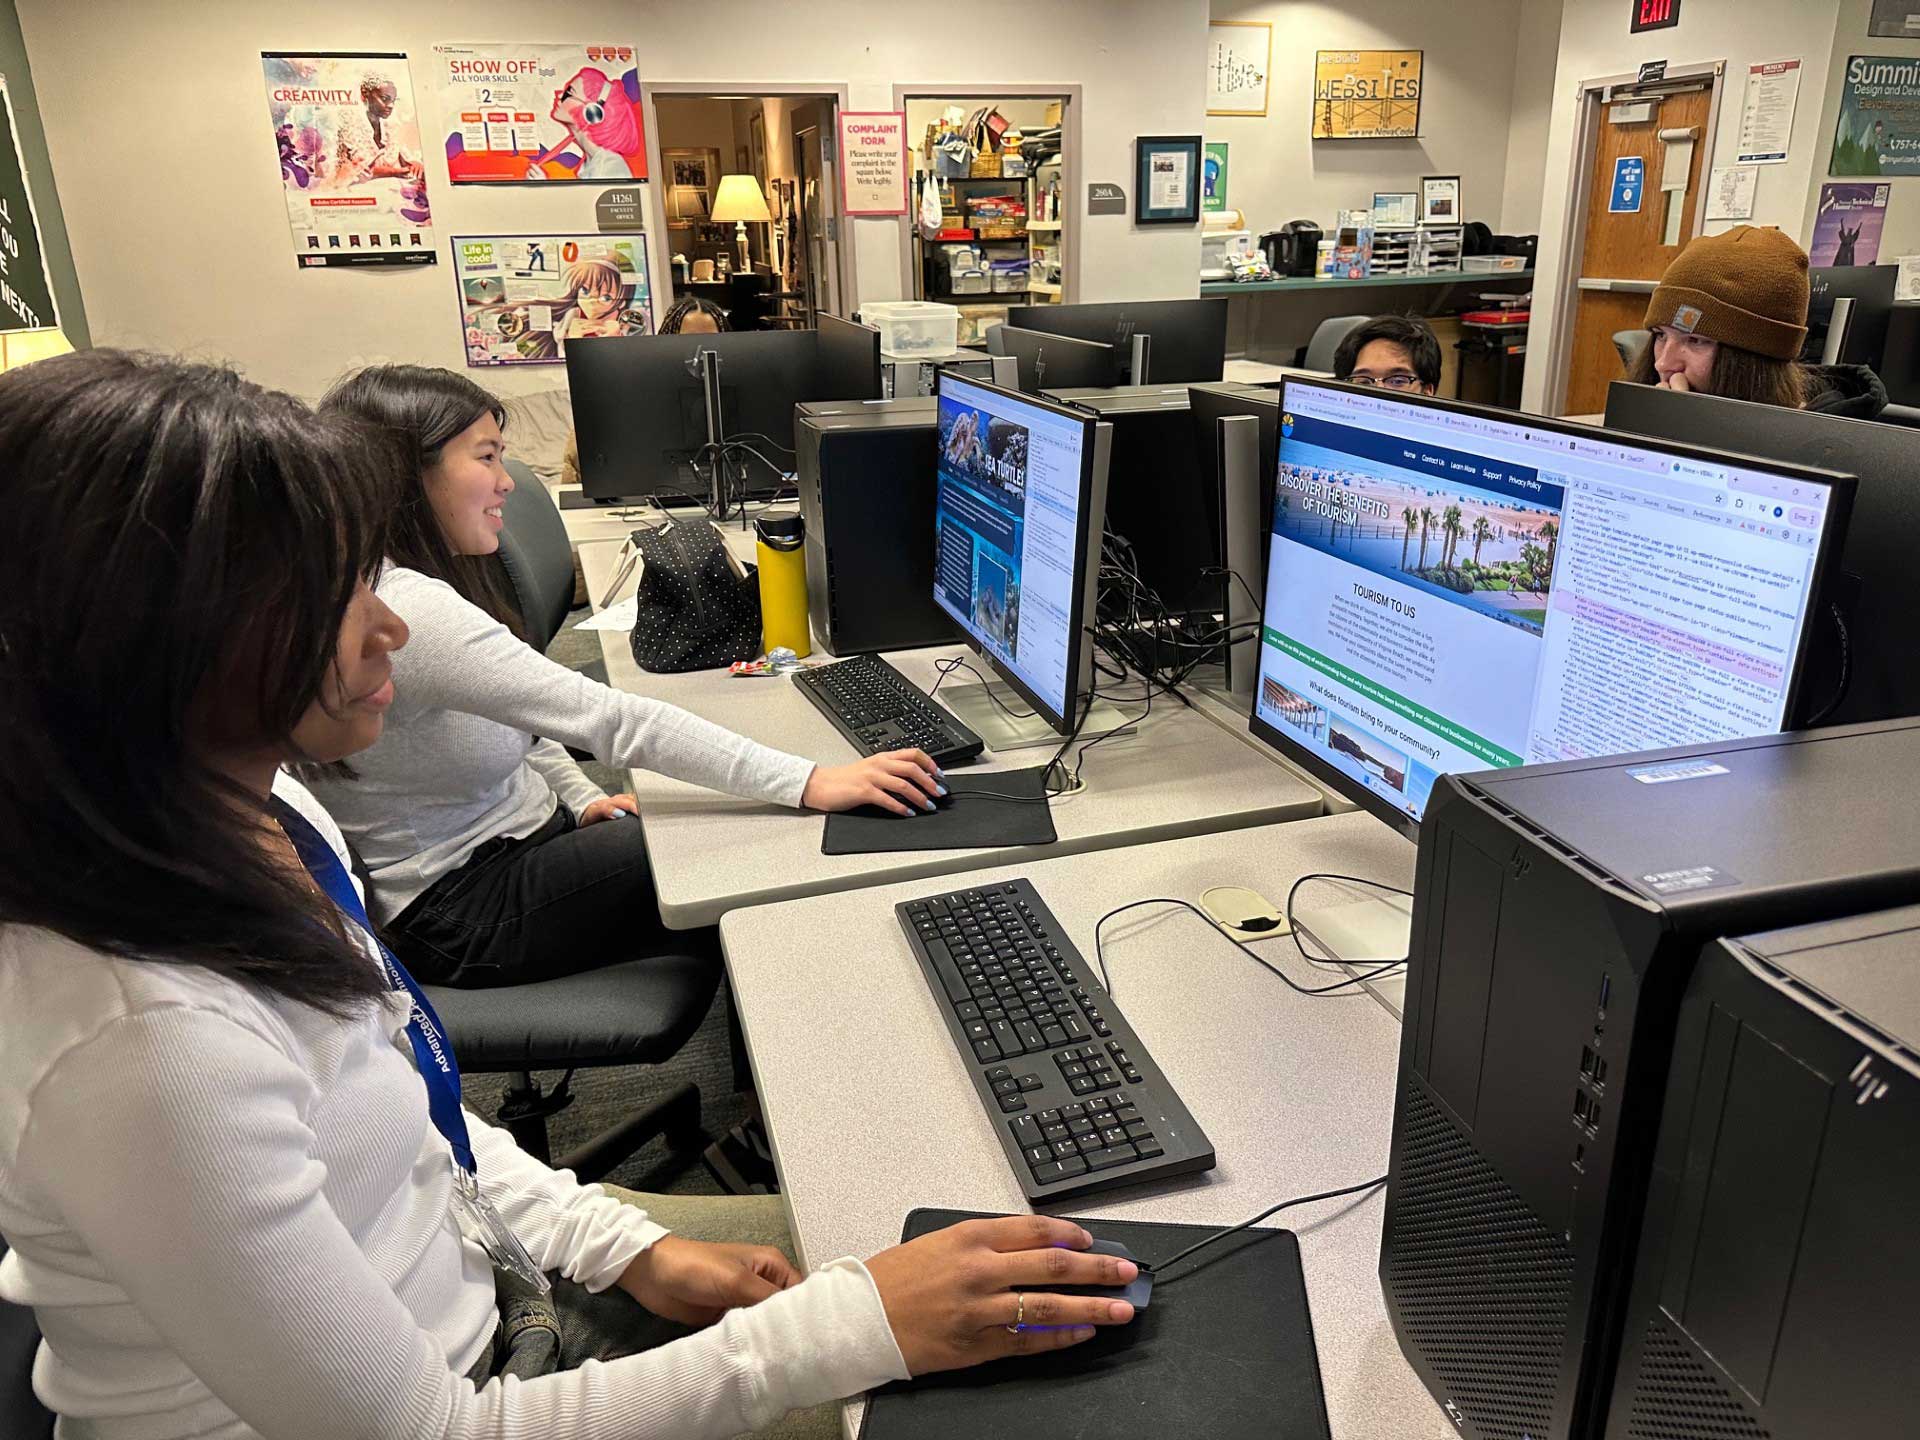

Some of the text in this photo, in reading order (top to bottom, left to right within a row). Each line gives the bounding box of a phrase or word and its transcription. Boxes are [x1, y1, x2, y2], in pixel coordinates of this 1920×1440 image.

[450, 60, 537, 74] SHOW OFF
[1848, 57, 1920, 85] Summi
[452, 75, 466, 83] ALL
[1318, 68, 1418, 98] WEBSITES
[273, 89, 352, 101] CREATIVITY
[482, 89, 492, 103] 2
[1854, 84, 1883, 97] Design
[847, 125, 898, 134] COMPLAINT
[860, 136, 886, 145] FORM
[849, 150, 867, 158] Please
[612, 194, 633, 203] H261
[463, 244, 492, 255] Life in
[467, 255, 491, 264] code
[1403, 449, 1416, 459] Home
[1421, 453, 1445, 466] Contact Us
[984, 454, 1025, 488] SEA TURTLES
[1449, 461, 1476, 474] Learn More
[1482, 468, 1502, 480] Support
[1508, 474, 1526, 488] Privacy
[1526, 479, 1541, 492] Policy
[1279, 471, 1388, 519] DISCOVER THE BENEFITS
[1302, 496, 1357, 526] OF TOURISM
[1353, 582, 1416, 619] TOURISM TO US
[1308, 679, 1440, 759] What does tourism bring to your community?
[412, 1013, 451, 1073] Advanced
[1444, 1398, 1465, 1428] Z2
